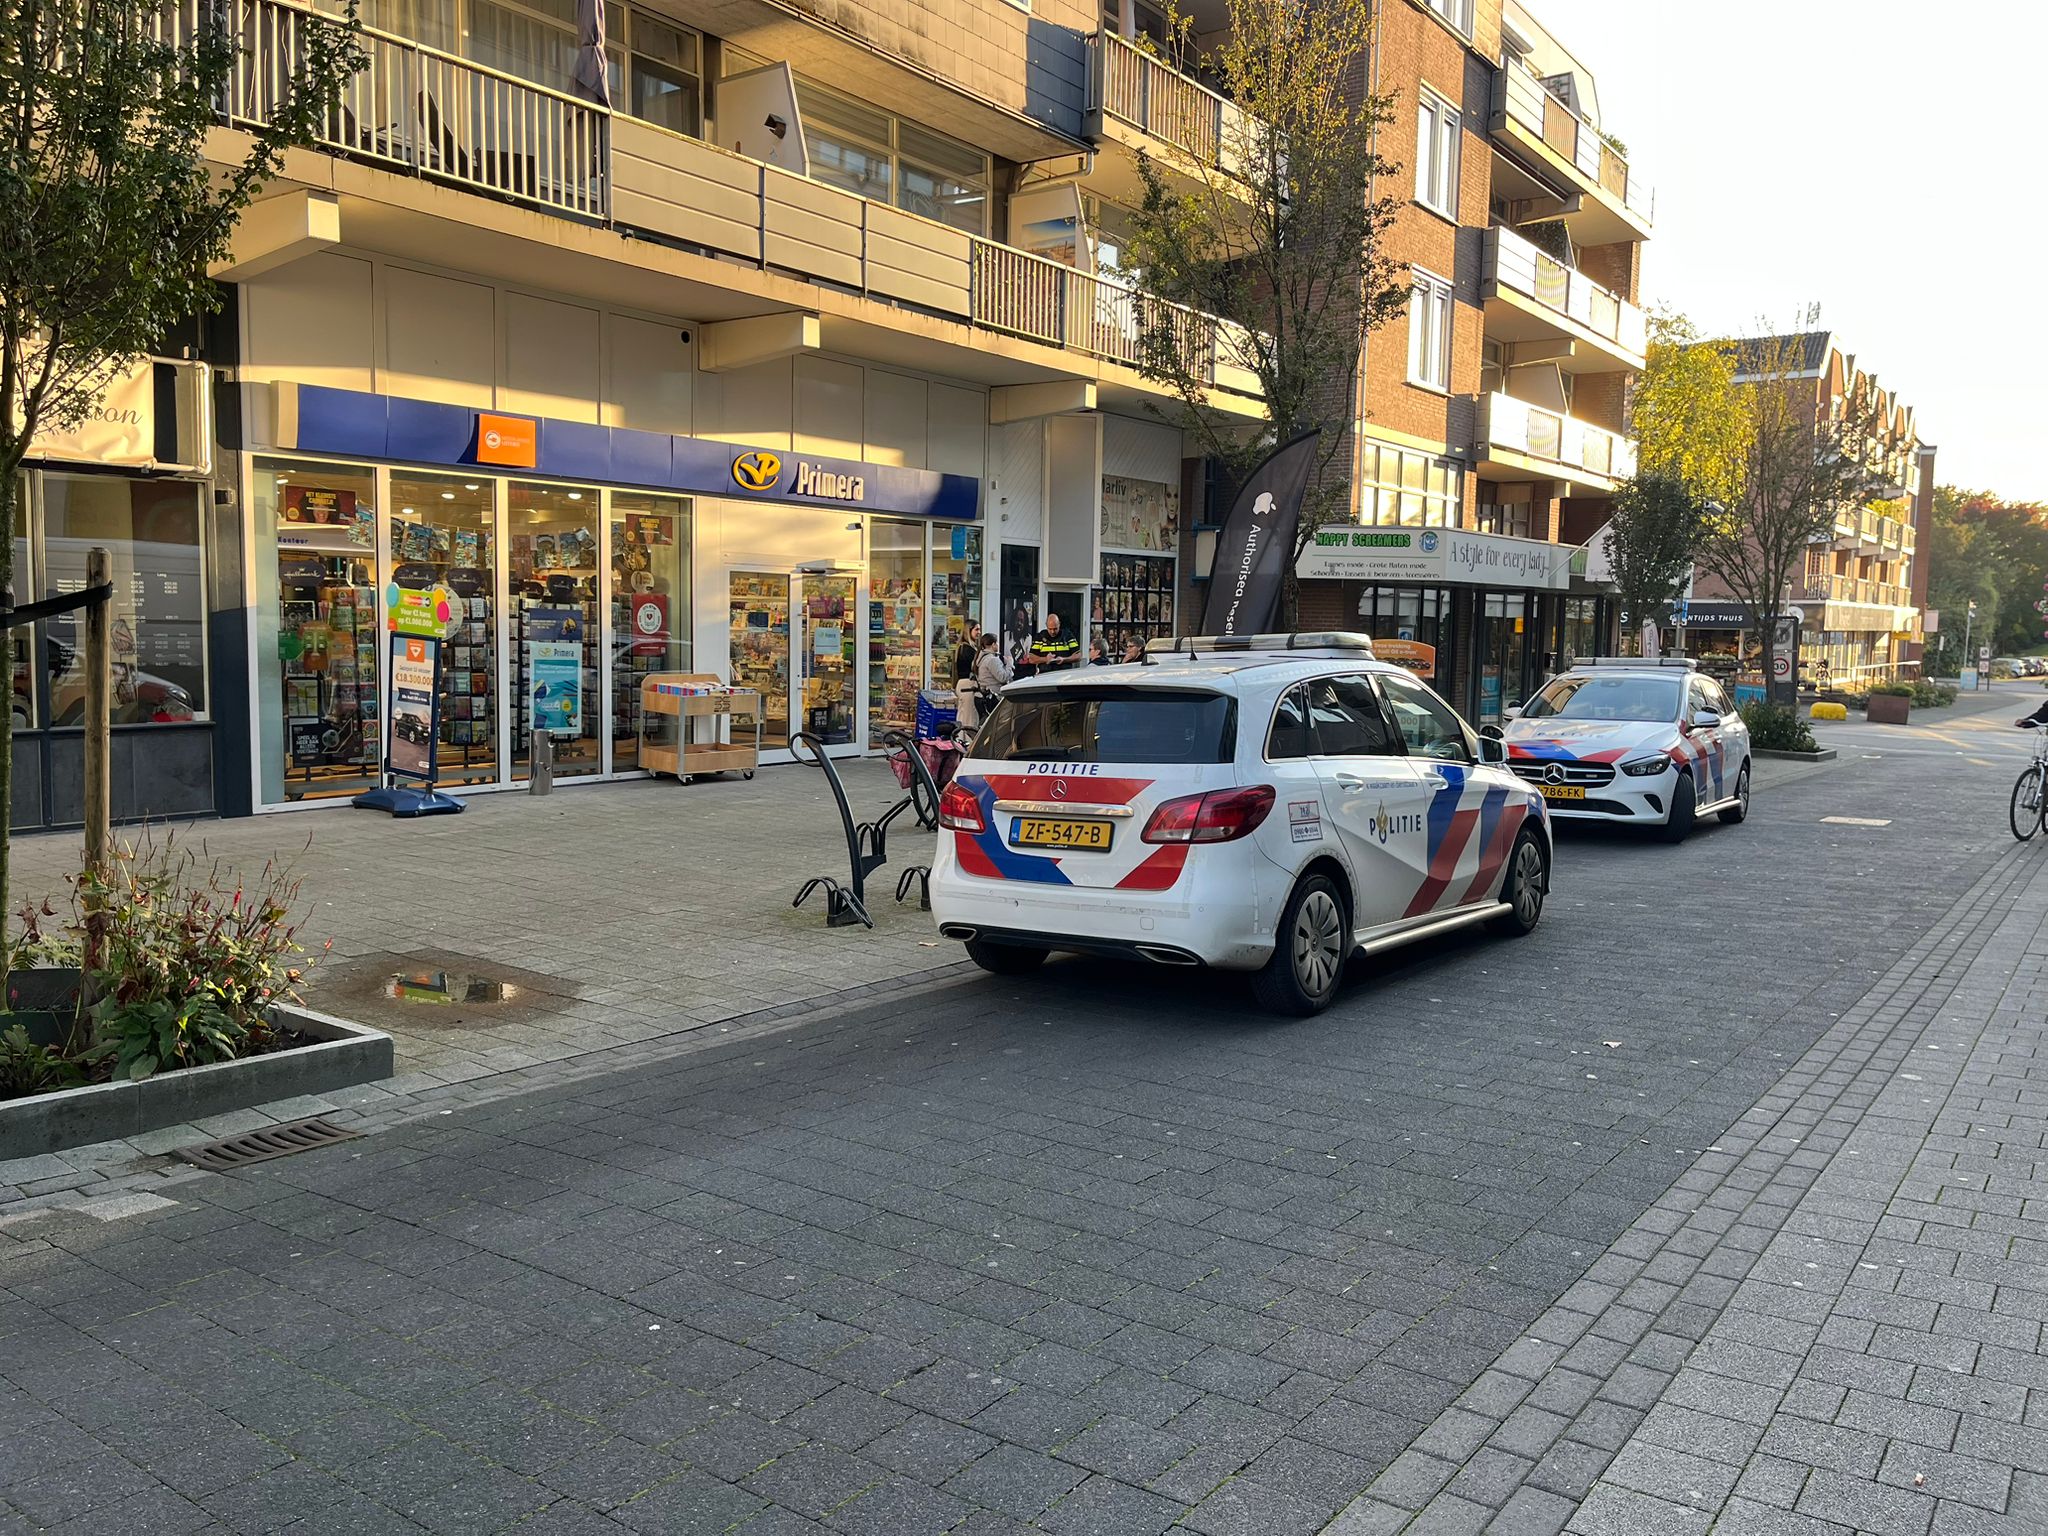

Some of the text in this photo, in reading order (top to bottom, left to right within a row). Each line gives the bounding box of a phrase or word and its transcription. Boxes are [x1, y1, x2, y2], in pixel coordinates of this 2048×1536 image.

[797, 461, 864, 501] Primera
[1315, 532, 1411, 548] HAPPY SCREAMERS
[1450, 541, 1457, 562] A
[1460, 542, 1483, 573] style
[1486, 545, 1500, 566] for
[1503, 551, 1527, 577] every
[1669, 614, 1743, 623] ENTIJDS THUIS
[553, 648, 575, 657] Primera
[1774, 662, 1786, 671] 30
[1027, 763, 1100, 775] POLITIE
[1538, 786, 1580, 797] -786-FK
[1025, 822, 1101, 844] ZF-547-B
[1369, 814, 1421, 844] POLITIE
